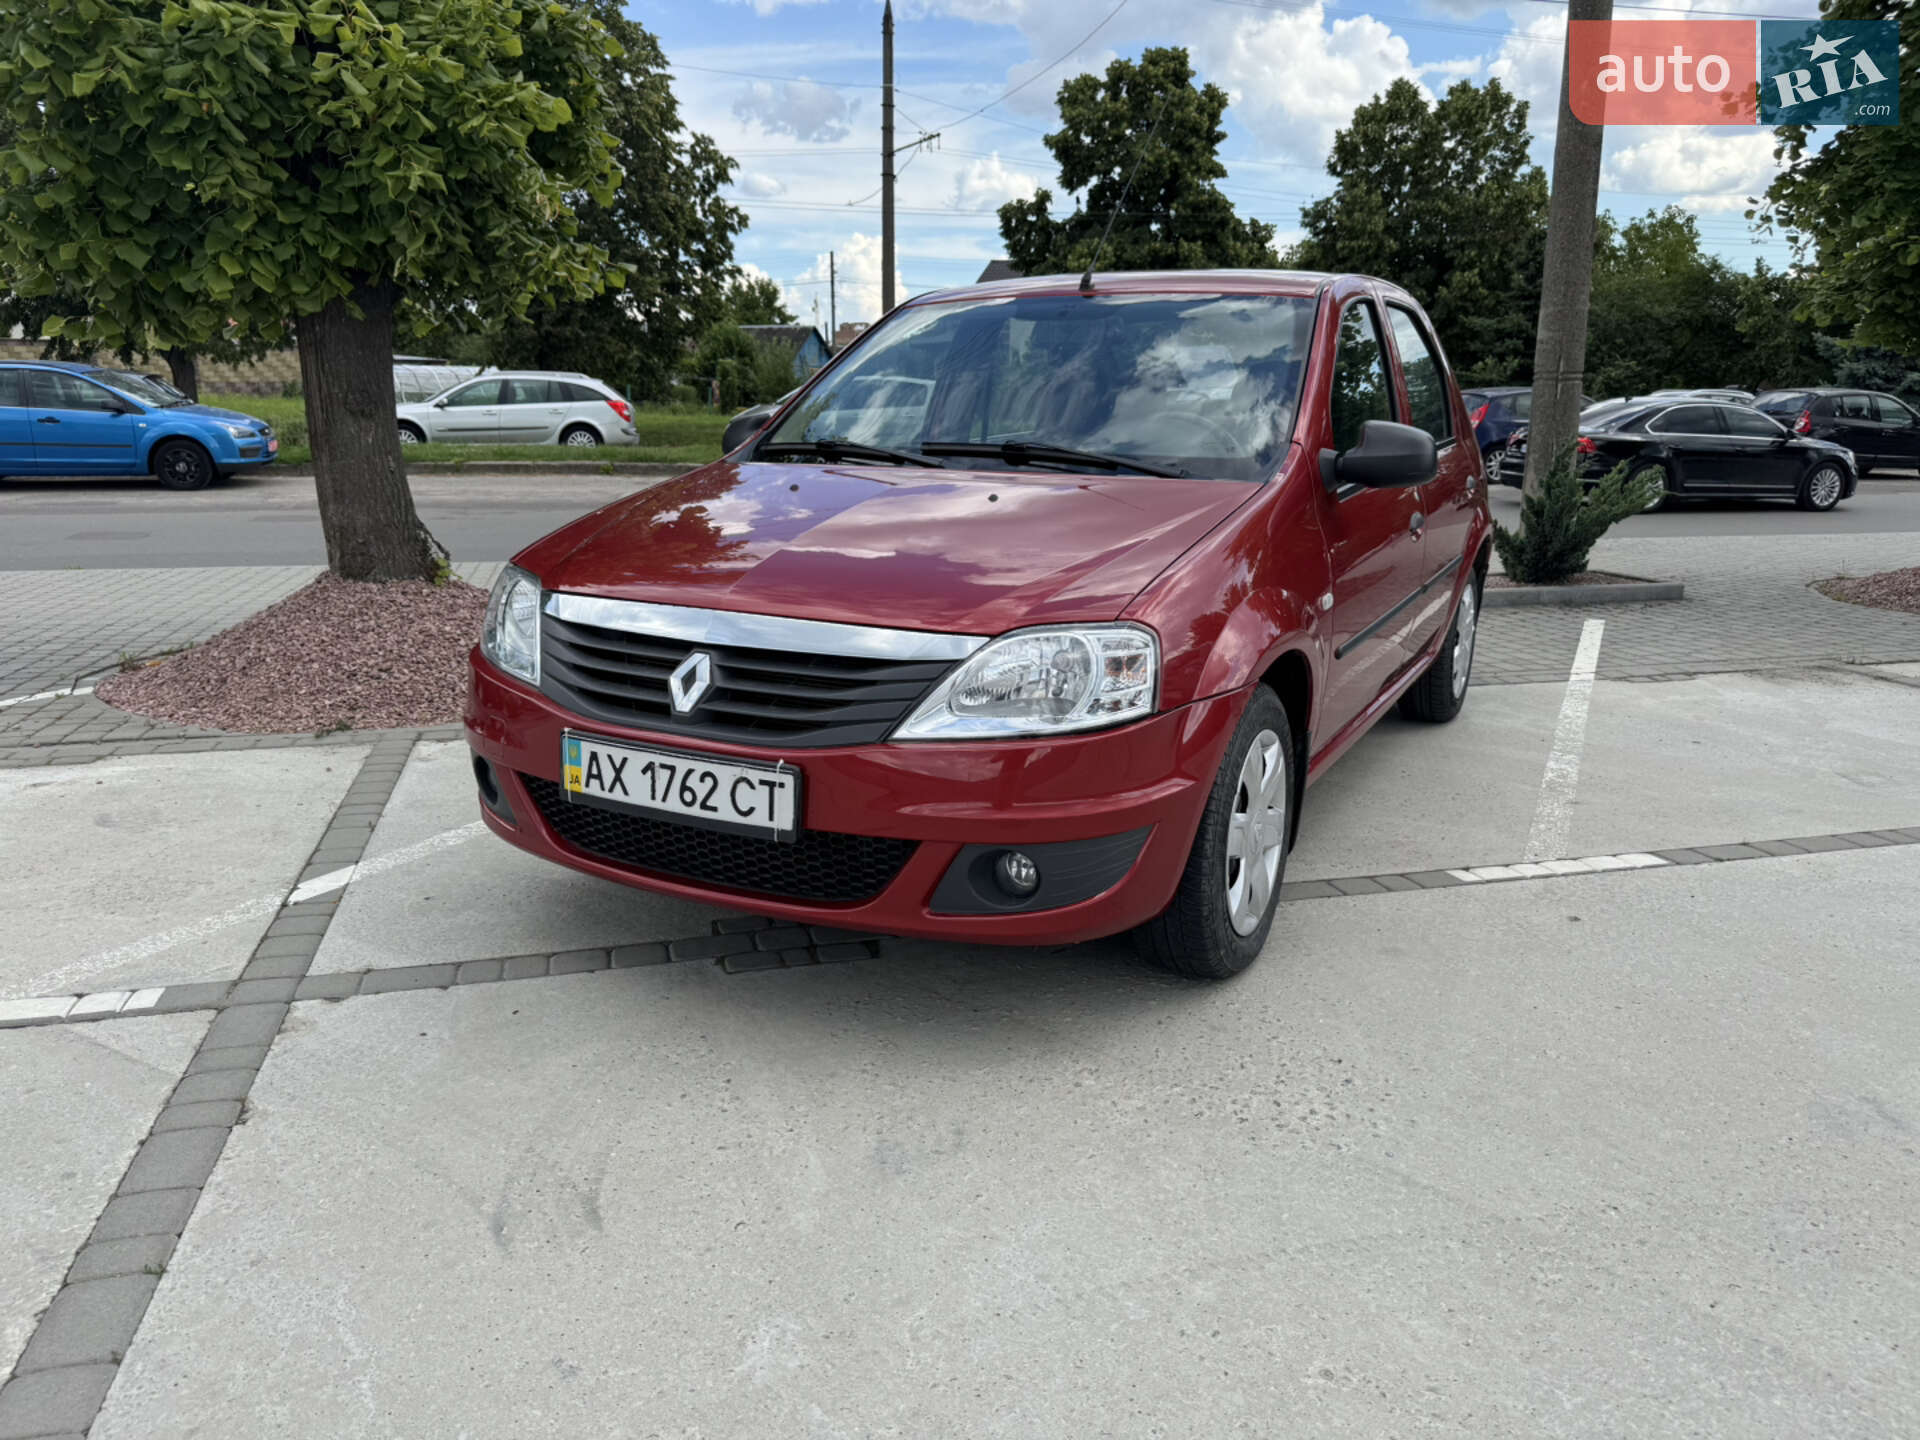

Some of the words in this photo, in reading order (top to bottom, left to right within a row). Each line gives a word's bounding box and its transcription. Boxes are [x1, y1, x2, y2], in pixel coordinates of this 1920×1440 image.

[584, 751, 630, 796] AX
[641, 761, 719, 813] 1762
[729, 776, 785, 822] CT
